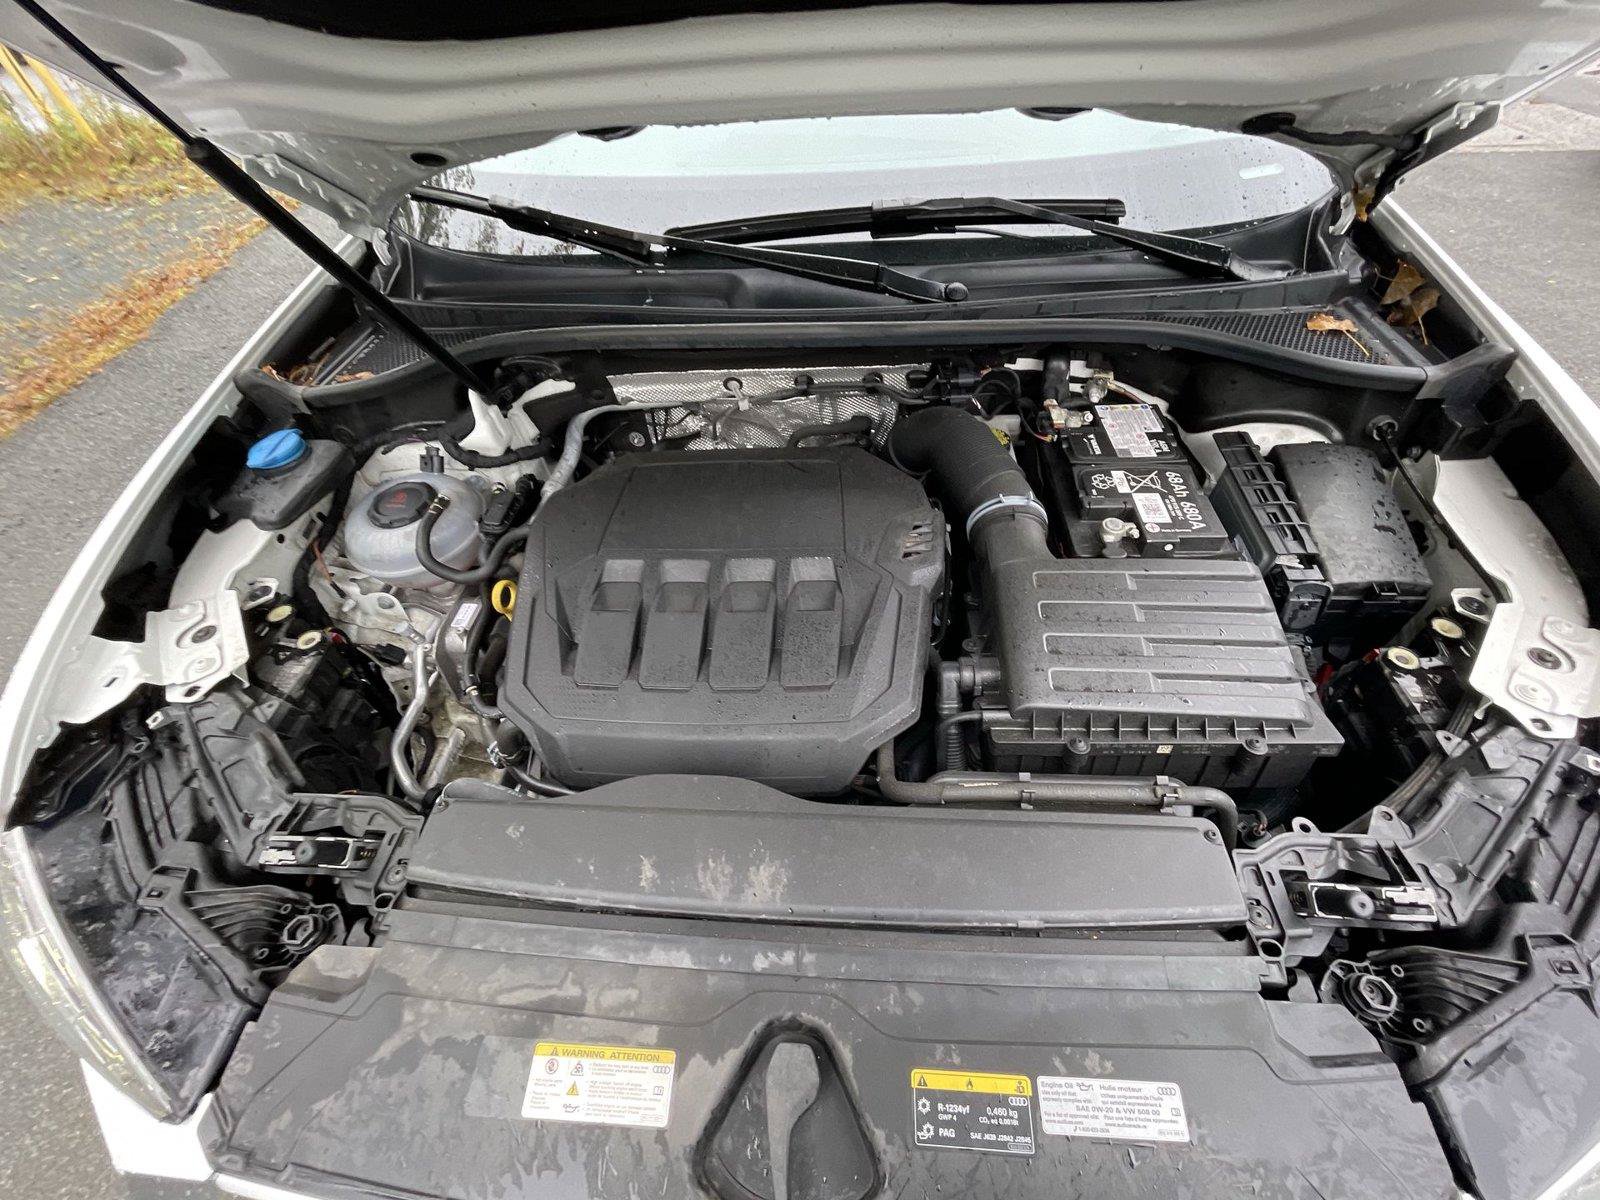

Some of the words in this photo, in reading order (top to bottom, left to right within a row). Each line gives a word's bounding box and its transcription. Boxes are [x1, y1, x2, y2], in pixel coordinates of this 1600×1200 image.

[1165, 471, 1190, 498] 68Ah
[1180, 501, 1207, 530] 680A
[562, 1048, 606, 1059] WARNING
[609, 1051, 660, 1062] ATTENTION
[937, 1102, 970, 1115] R-1234yf
[1008, 1108, 1018, 1119] kg
[1075, 1105, 1090, 1113] SAE
[1091, 1106, 1114, 1114] 0W-20
[938, 1113, 952, 1121] GWP
[938, 1127, 956, 1138] PAG
[969, 1132, 982, 1140] SAE
